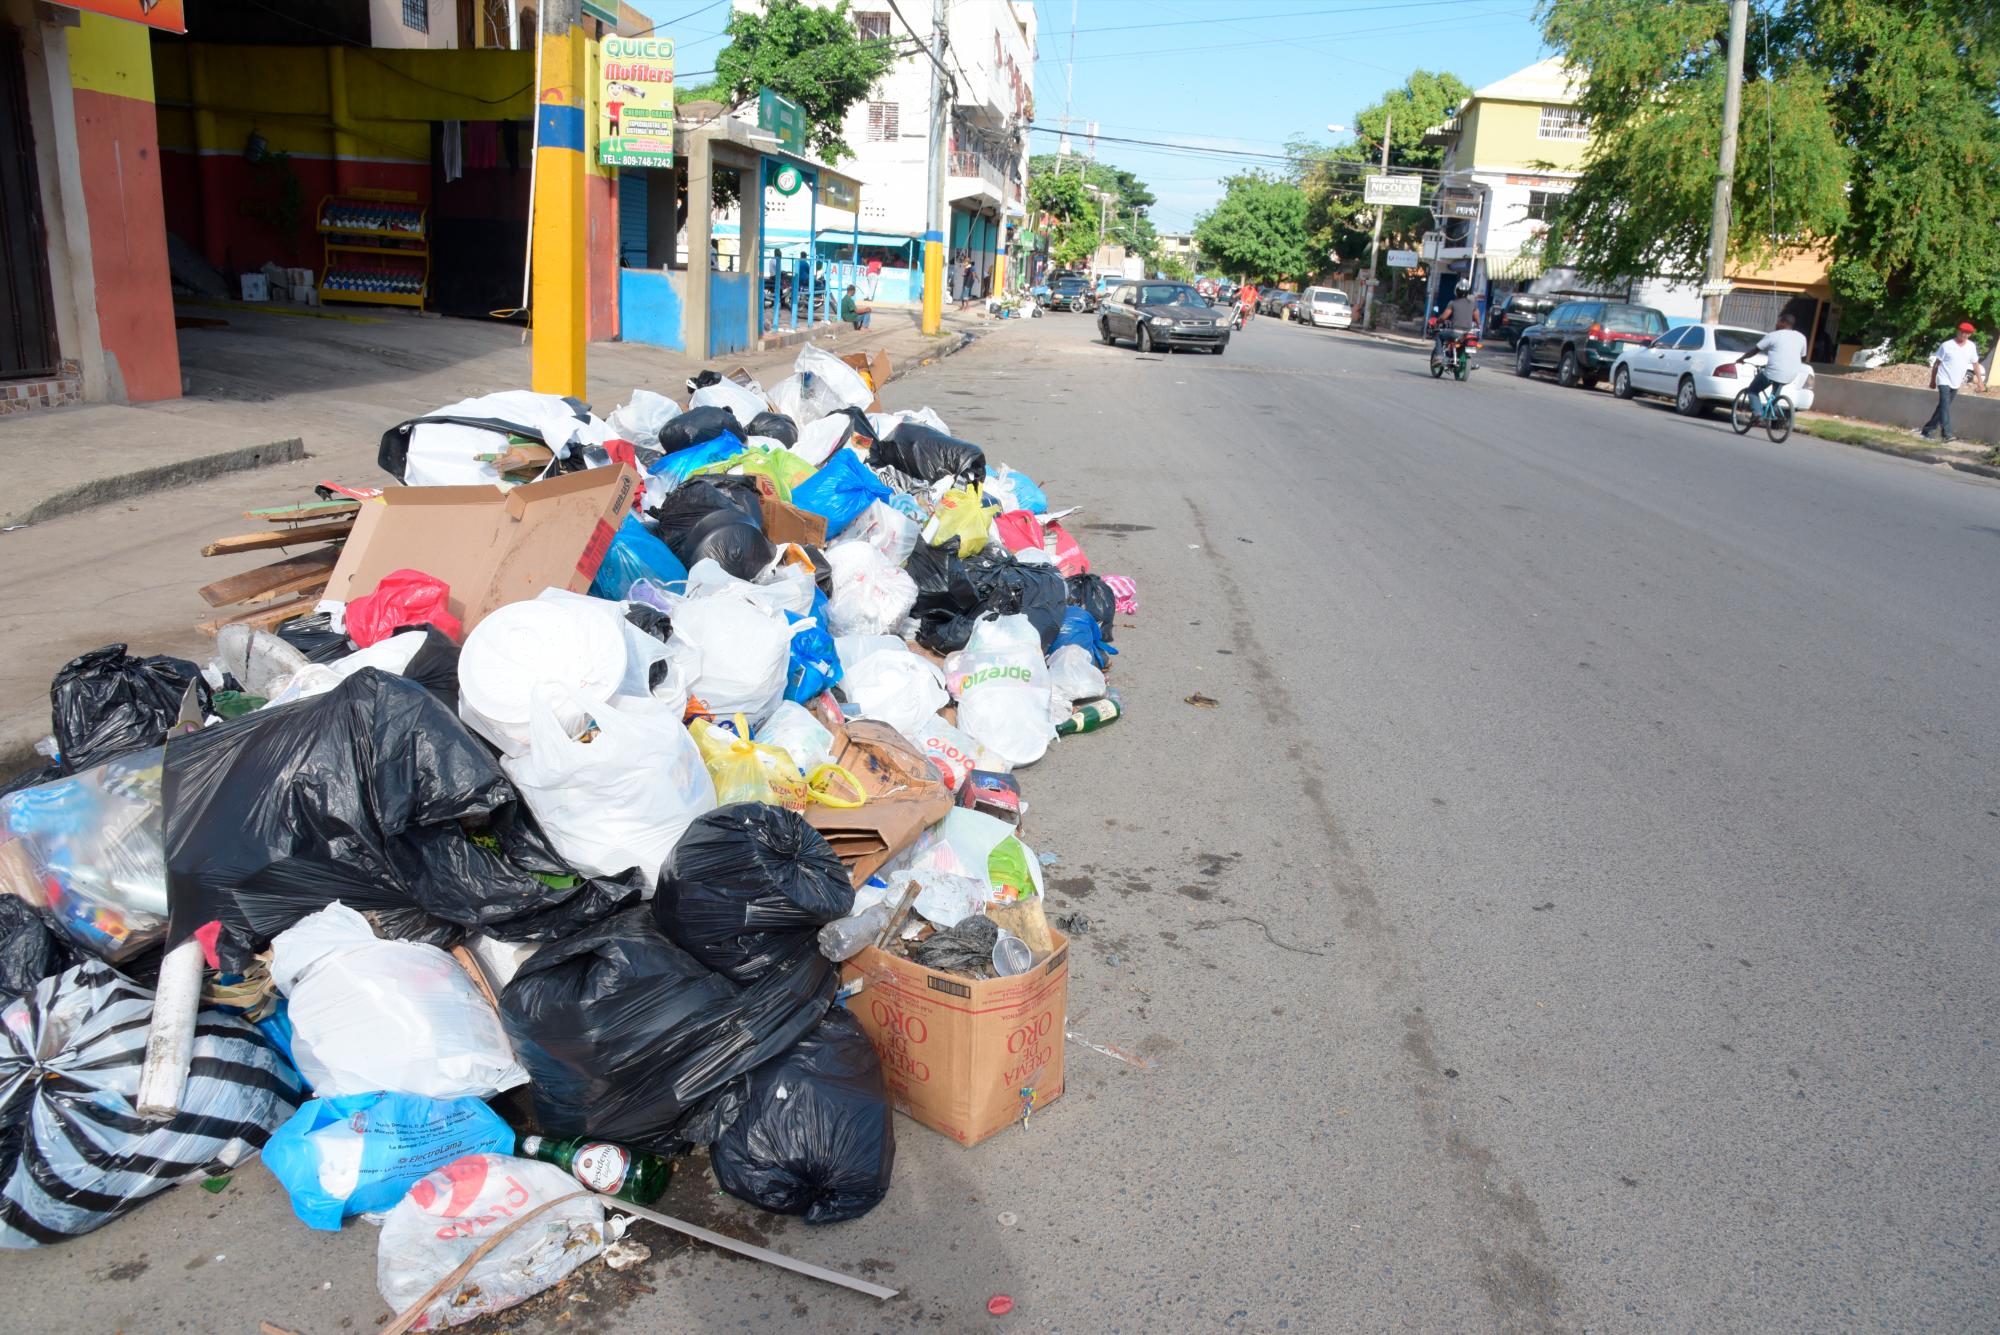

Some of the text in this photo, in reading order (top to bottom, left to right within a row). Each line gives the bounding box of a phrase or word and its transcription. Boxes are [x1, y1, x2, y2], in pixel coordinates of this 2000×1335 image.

[606, 40, 673, 58] QUICO
[604, 63, 673, 83] Mufflers
[623, 156, 671, 167] 809-748-7242
[1371, 182, 1417, 193] NICOLAS
[960, 666, 1032, 693] aprezio
[870, 999, 928, 1044] ORO
[1006, 1012, 1053, 1054] ORO
[888, 1034, 907, 1053] DE
[1023, 1041, 1039, 1059] DE
[1002, 1046, 1052, 1088] CREMA
[408, 1140, 462, 1163] ElectroLama
